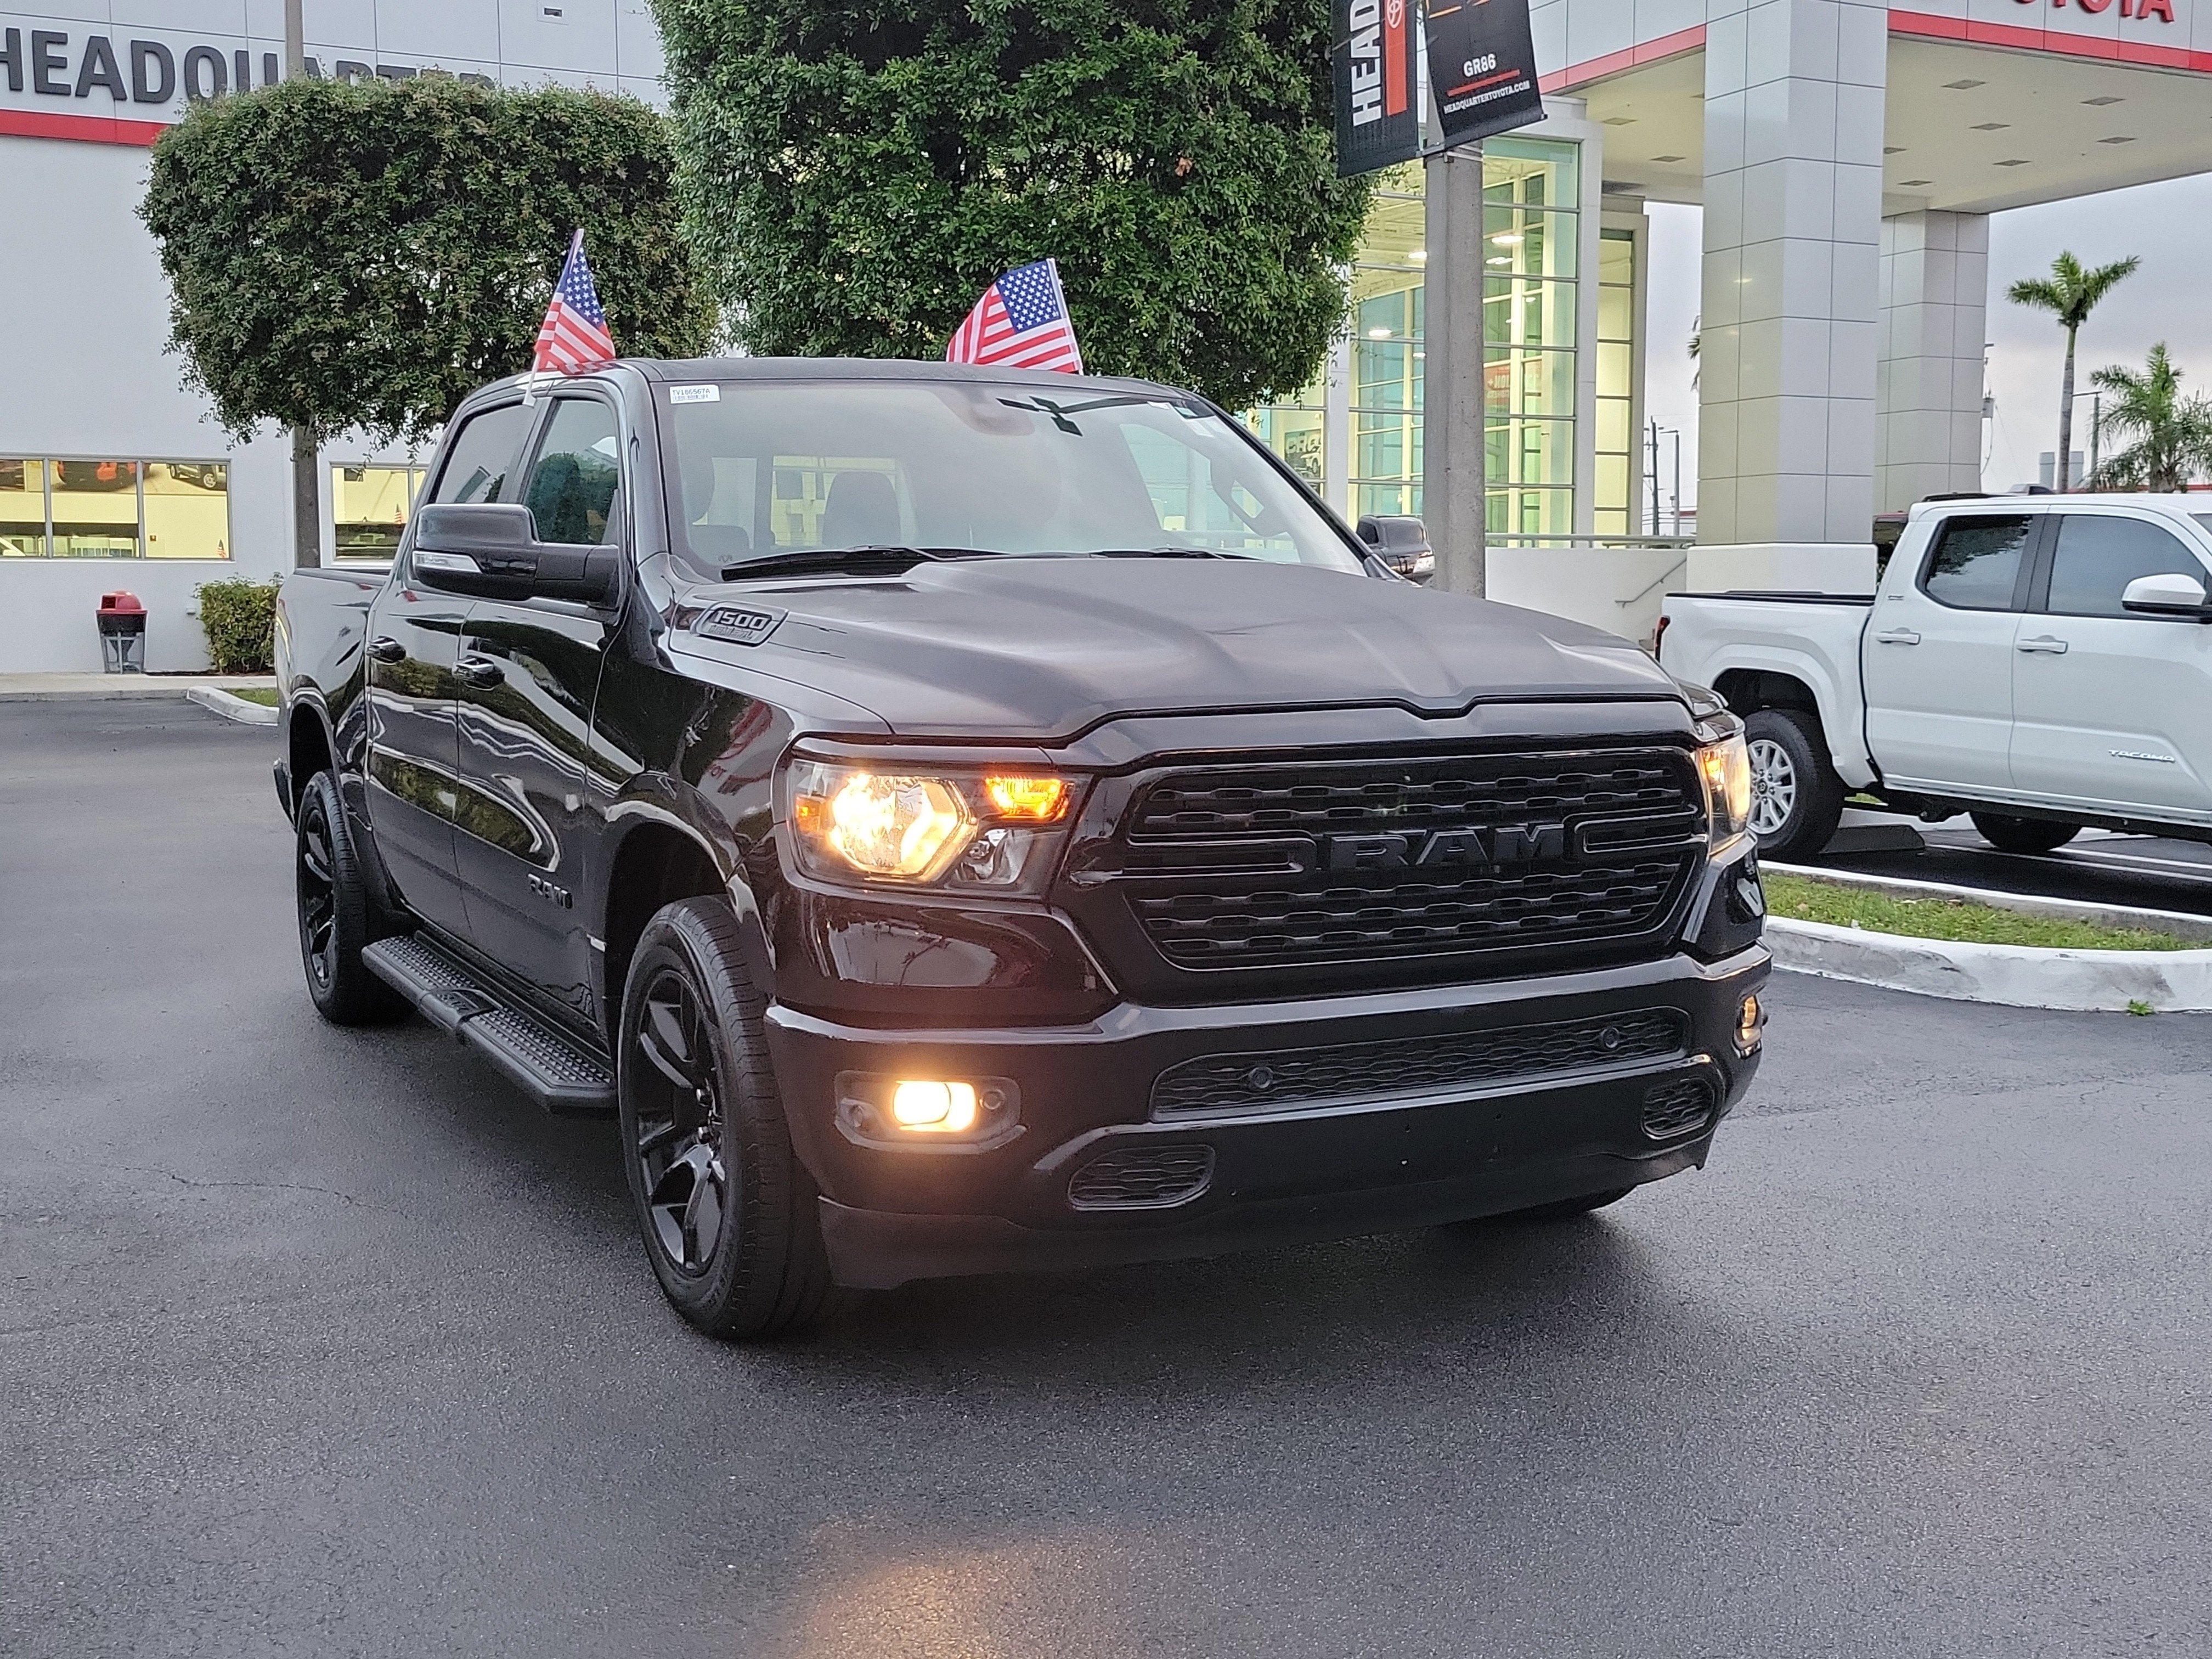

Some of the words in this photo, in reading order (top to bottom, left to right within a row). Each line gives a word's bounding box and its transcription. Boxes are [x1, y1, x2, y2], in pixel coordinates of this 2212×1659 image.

[0, 27, 498, 103] HEADQU
[1349, 0, 1382, 127] HEAD
[1463, 53, 1497, 77] GR86
[1443, 80, 1531, 114] HEADQUARTERTOYOTA.COM
[713, 610, 768, 630] 1500
[2108, 749, 2175, 763] TACOMA
[1330, 823, 1565, 870] RAM
[527, 873, 574, 909] RAM
